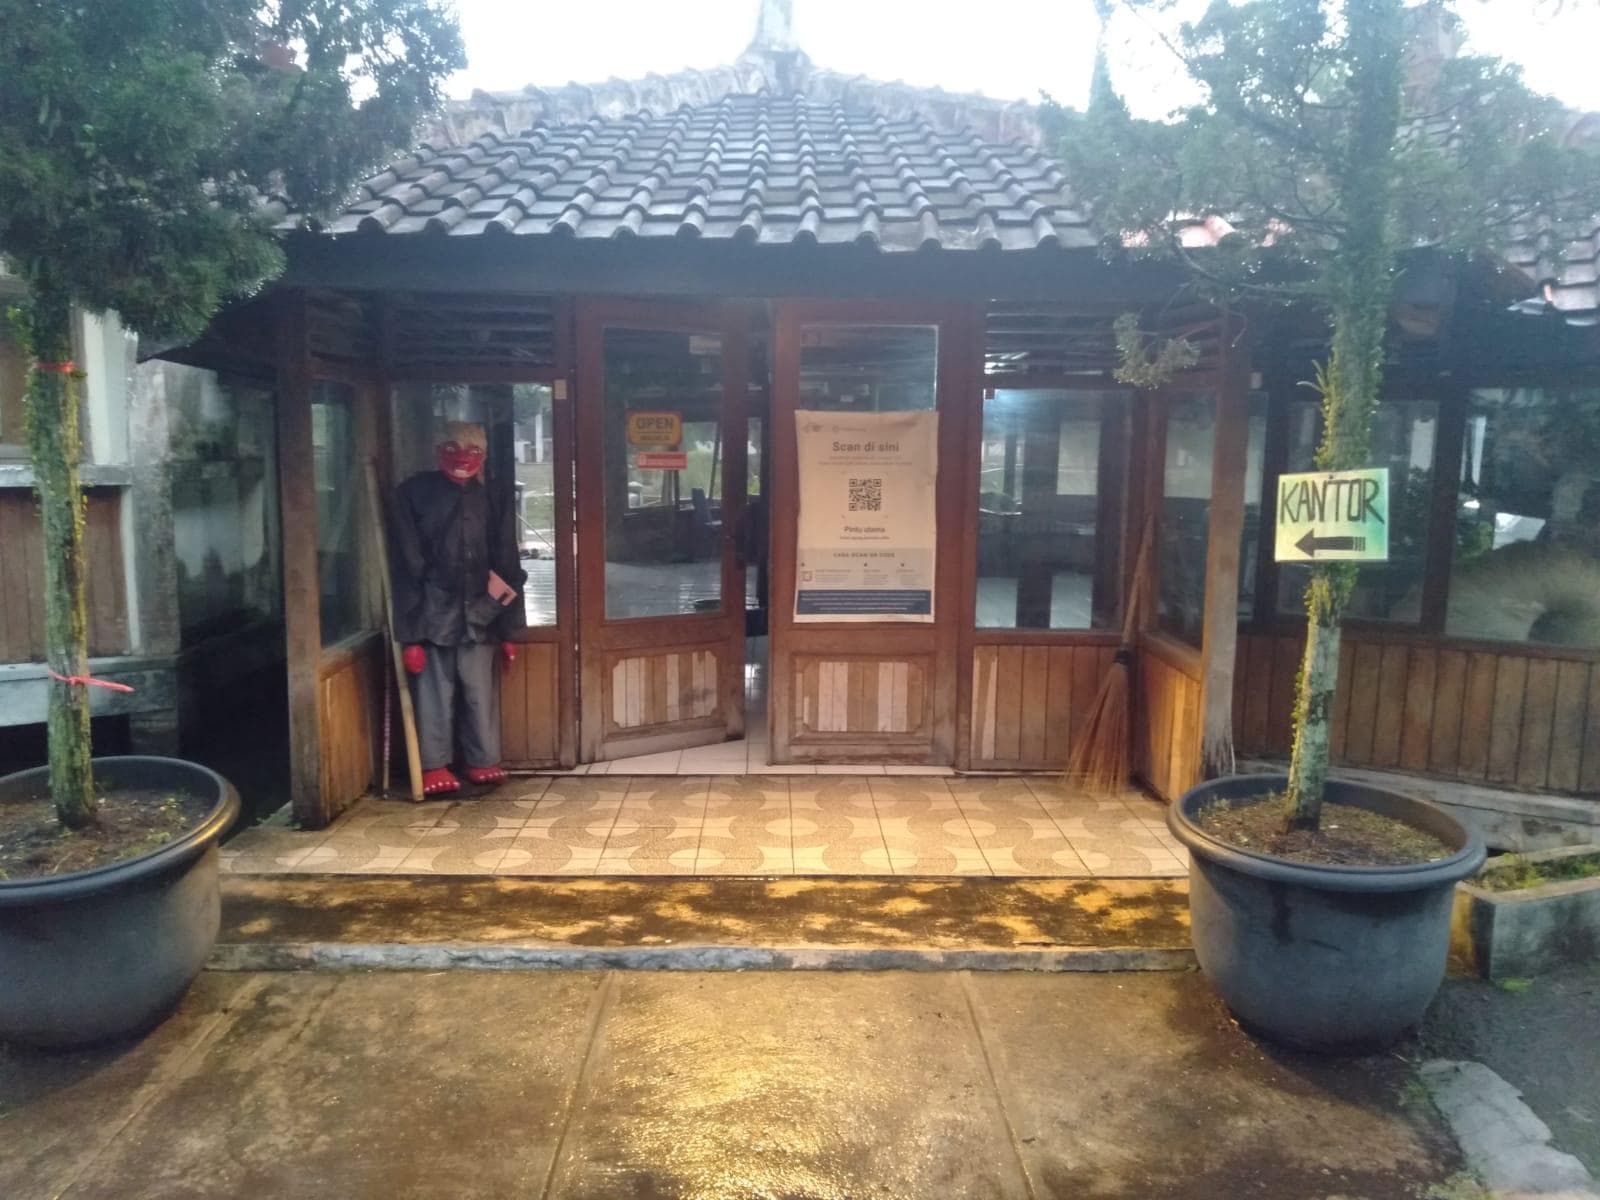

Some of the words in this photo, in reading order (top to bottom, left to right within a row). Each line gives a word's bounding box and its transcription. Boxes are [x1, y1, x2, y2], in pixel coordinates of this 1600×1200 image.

[636, 416, 674, 430] OPEN
[832, 441, 861, 452] Scan
[864, 441, 875, 452] di
[878, 441, 900, 452] sini
[1279, 478, 1385, 525] KANTOR
